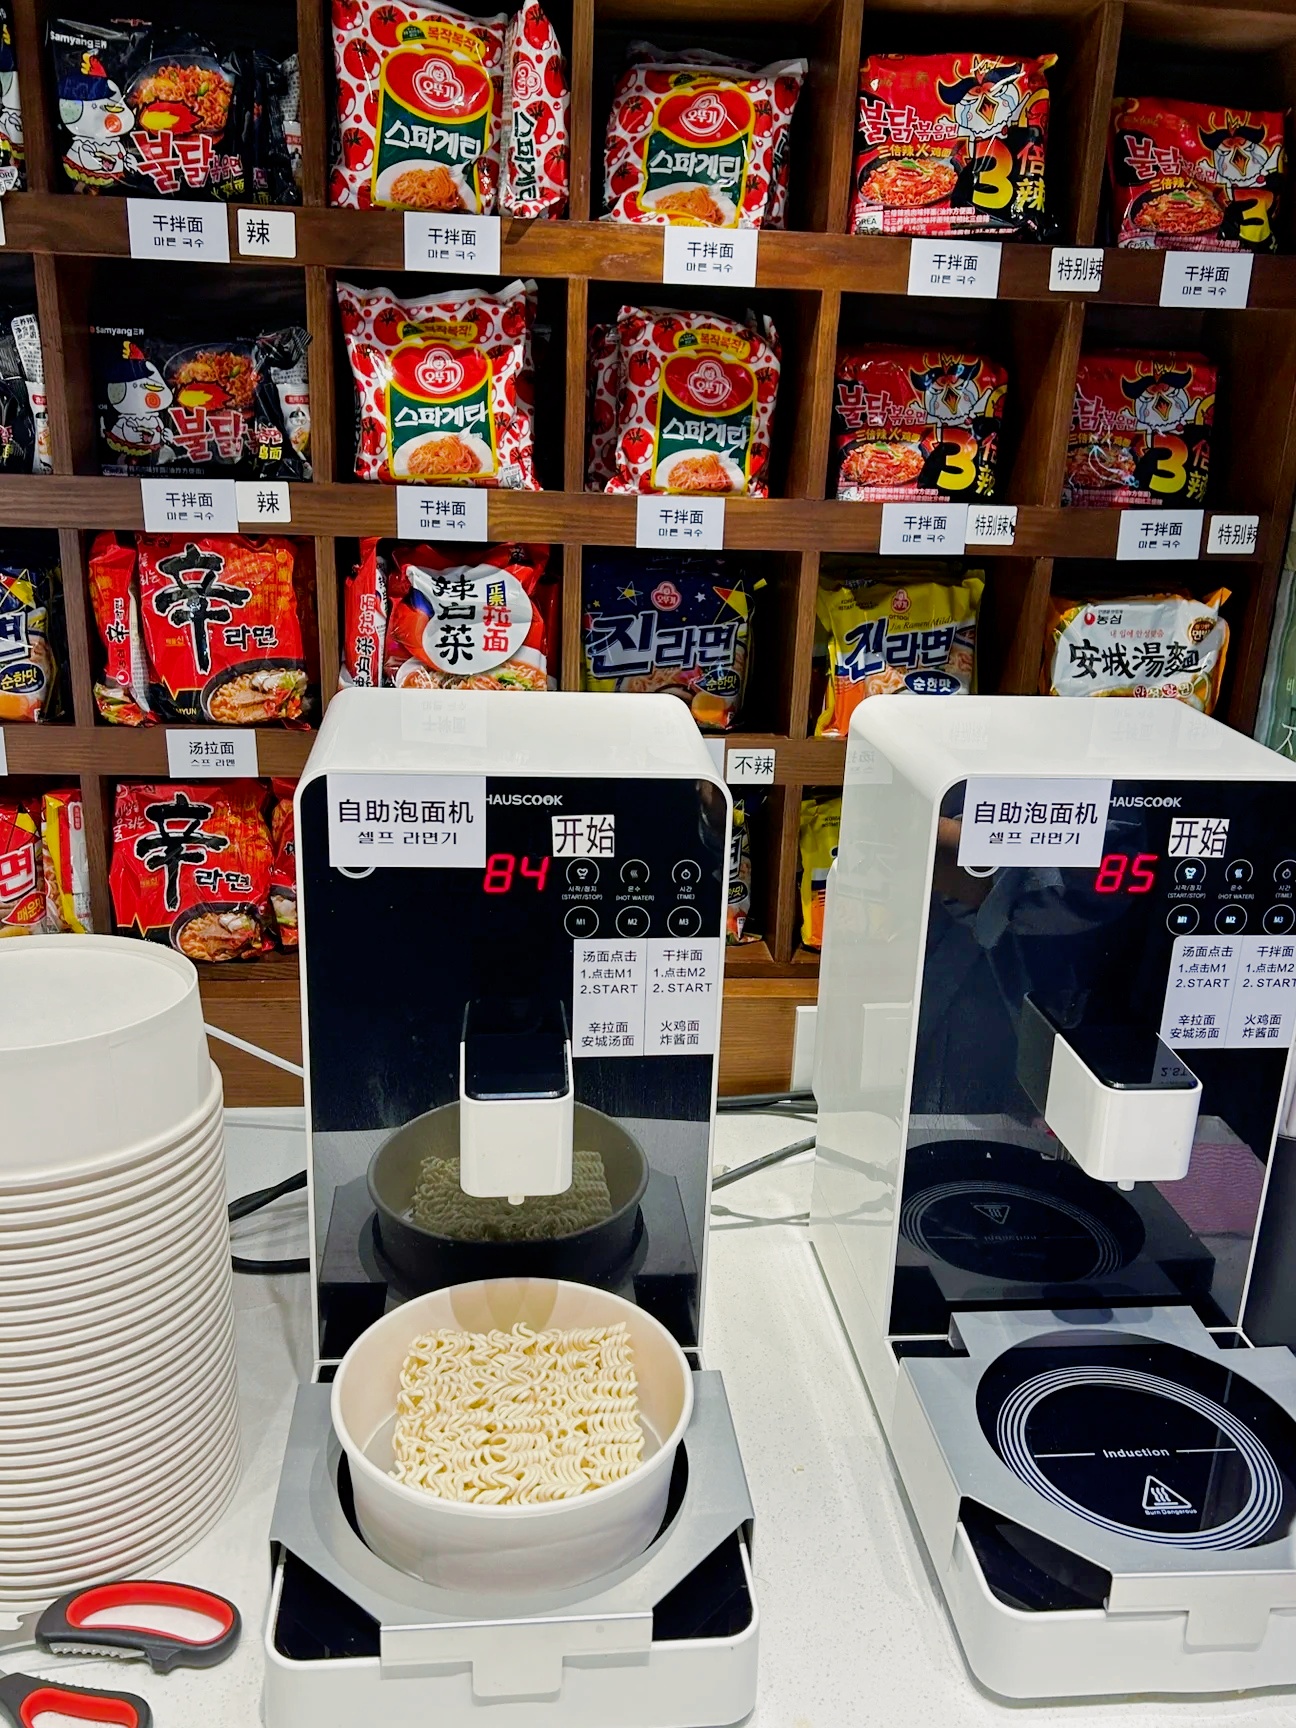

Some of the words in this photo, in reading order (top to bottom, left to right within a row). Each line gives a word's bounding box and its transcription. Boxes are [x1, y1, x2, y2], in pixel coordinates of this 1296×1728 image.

[50, 30, 94, 48] Samyang
[422, 80, 454, 99] 오뚜기
[687, 109, 717, 125] 오뚜기
[385, 120, 481, 160] 스파게티
[650, 149, 742, 184] 스파게티
[153, 215, 203, 234] 干拌面
[246, 219, 270, 245] 辣
[428, 228, 477, 247] 干拌面
[154, 236, 176, 248] 마른
[182, 237, 204, 248] 국수
[428, 249, 450, 259] 마른
[455, 250, 477, 260] 국수
[687, 241, 734, 259] 干拌面
[686, 262, 707, 272] 마른
[712, 263, 733, 273] 국수
[932, 254, 978, 271] 干拌面
[1058, 257, 1103, 281] 特别辣
[930, 274, 951, 284] 마른
[955, 275, 976, 285] 국수
[1184, 266, 1230, 282] 干拌面
[1182, 286, 1203, 296] 마른
[1207, 287, 1227, 296] 국수
[96, 326, 132, 336] Samyang
[424, 370, 455, 384] 오뚜기
[395, 401, 489, 428] 스파게티
[662, 417, 748, 449] 스파게티
[165, 491, 213, 508] 干拌面
[257, 491, 280, 513] 辣
[420, 500, 466, 517] 干拌面
[167, 511, 188, 521] 마른
[194, 511, 214, 521] 국수
[659, 509, 703, 525] 干拌面
[903, 515, 948, 531] 干拌面
[420, 519, 441, 529] 마른
[446, 520, 466, 529] 국수
[975, 514, 1009, 537] 特别辣
[1140, 522, 1183, 537] 干拌面
[658, 528, 678, 537] 마른
[684, 528, 703, 537] 국수
[902, 534, 923, 543] 마른
[927, 534, 946, 543] 국수
[1138, 540, 1157, 549] 마른
[1162, 541, 1181, 549] 국수
[153, 542, 252, 676] 辛
[223, 624, 279, 650] 라면
[431, 574, 479, 666] 辣白菜
[1097, 615, 1122, 625] 농심
[1110, 629, 1117, 637] 내
[1120, 629, 1134, 638] 입에
[585, 609, 738, 679] 진라면
[845, 617, 958, 684] 진라면
[0, 668, 37, 690] 순한맛
[912, 677, 952, 693] 순한맛
[189, 741, 234, 755] 汤拉面
[191, 759, 211, 767] 스프
[734, 755, 774, 775] 不辣
[339, 798, 474, 824] 自助泡面机
[974, 801, 1098, 825] 自助泡面机
[358, 831, 394, 844] 셀프
[403, 831, 457, 845] 라면기
[555, 817, 614, 854] 开始
[989, 832, 1022, 844] 셀프
[1030, 832, 1080, 845] 라면기
[1170, 819, 1228, 856] 开始
[134, 791, 230, 912] 辛
[194, 867, 253, 893] 라면
[484, 853, 549, 893] 84
[1095, 854, 1158, 893] 85
[628, 918, 638, 926] M2
[679, 918, 689, 926] M3
[1177, 916, 1188, 924] M1
[1225, 916, 1236, 924] M2
[1273, 916, 1284, 924] M3
[583, 950, 637, 963] 汤面点击
[663, 949, 703, 961] 干拌面
[1182, 946, 1234, 958] 汤面点击
[1256, 946, 1295, 957] 干拌面
[660, 1020, 700, 1032] 火鸡面
[1178, 1014, 1216, 1026] 辛拉面
[1244, 1014, 1282, 1025] 火鸡面
[588, 1022, 628, 1034] 辛拉面
[1170, 1027, 1220, 1039] 安城汤面
[1242, 1027, 1280, 1038] 炸酱面
[581, 1035, 635, 1047] 安城汤面
[660, 1034, 699, 1045] 炸酱面
[1103, 1447, 1170, 1459] Induction
